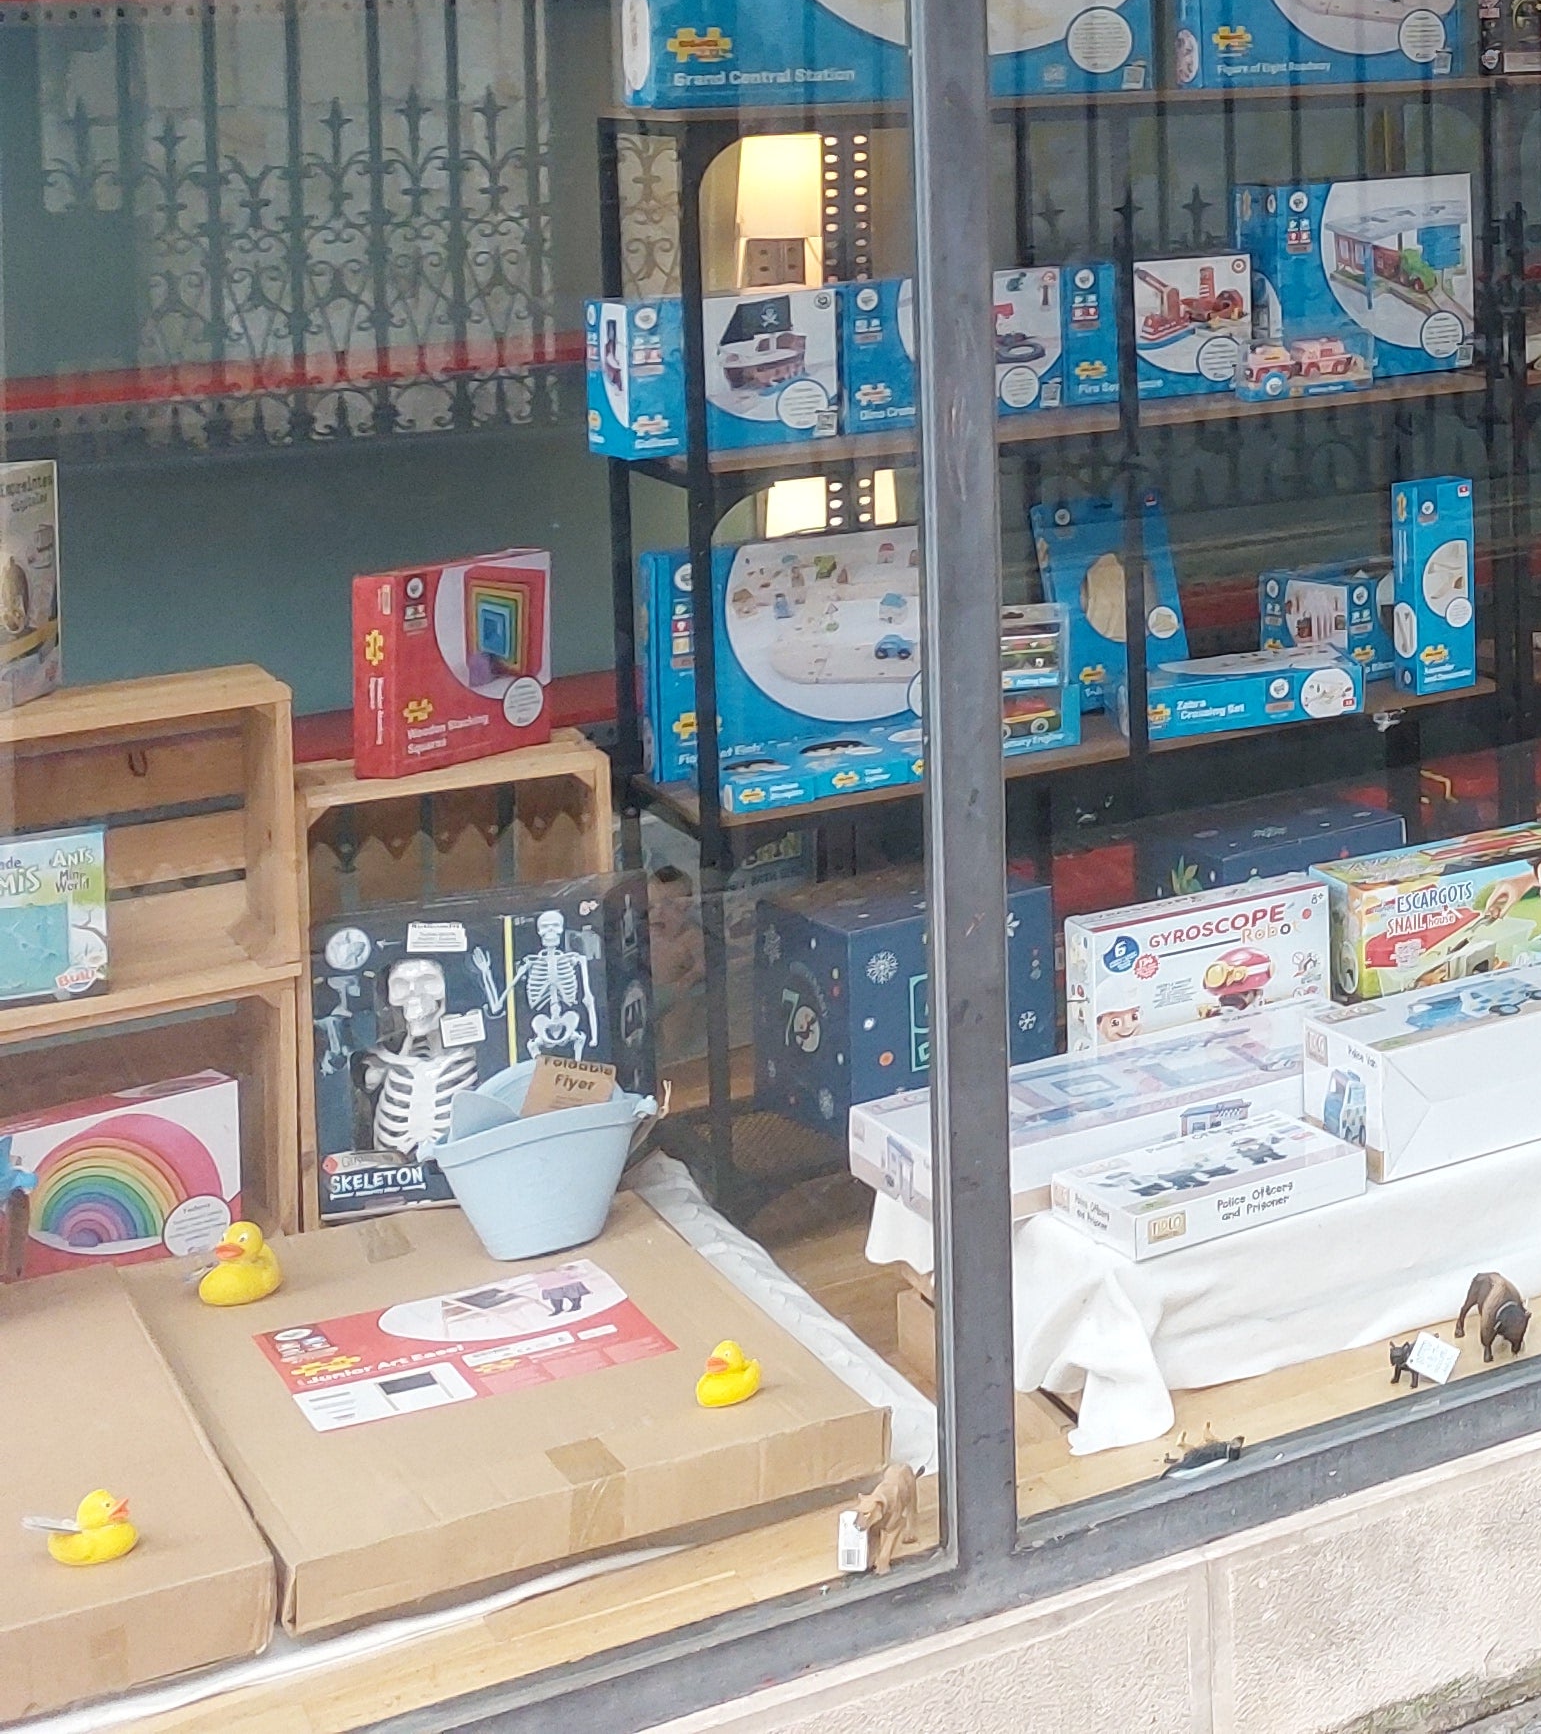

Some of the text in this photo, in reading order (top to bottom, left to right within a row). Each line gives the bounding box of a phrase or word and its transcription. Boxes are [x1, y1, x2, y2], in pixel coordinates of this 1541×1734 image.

[673, 68, 855, 87] Grand Central Station
[1397, 882, 1473, 913] ESCARGOTS
[1149, 902, 1287, 948] GYROSCOPE
[1240, 919, 1300, 944] Robot
[1386, 912, 1456, 937] SNAIL house
[1114, 940, 1127, 958] 6
[553, 1073, 596, 1093] Flyer
[330, 1166, 424, 1194] SKELETON
[1217, 1180, 1294, 1210] Police Officers
[1221, 1195, 1290, 1221] and Prisoner
[305, 1344, 466, 1385] Junior Art Easel
